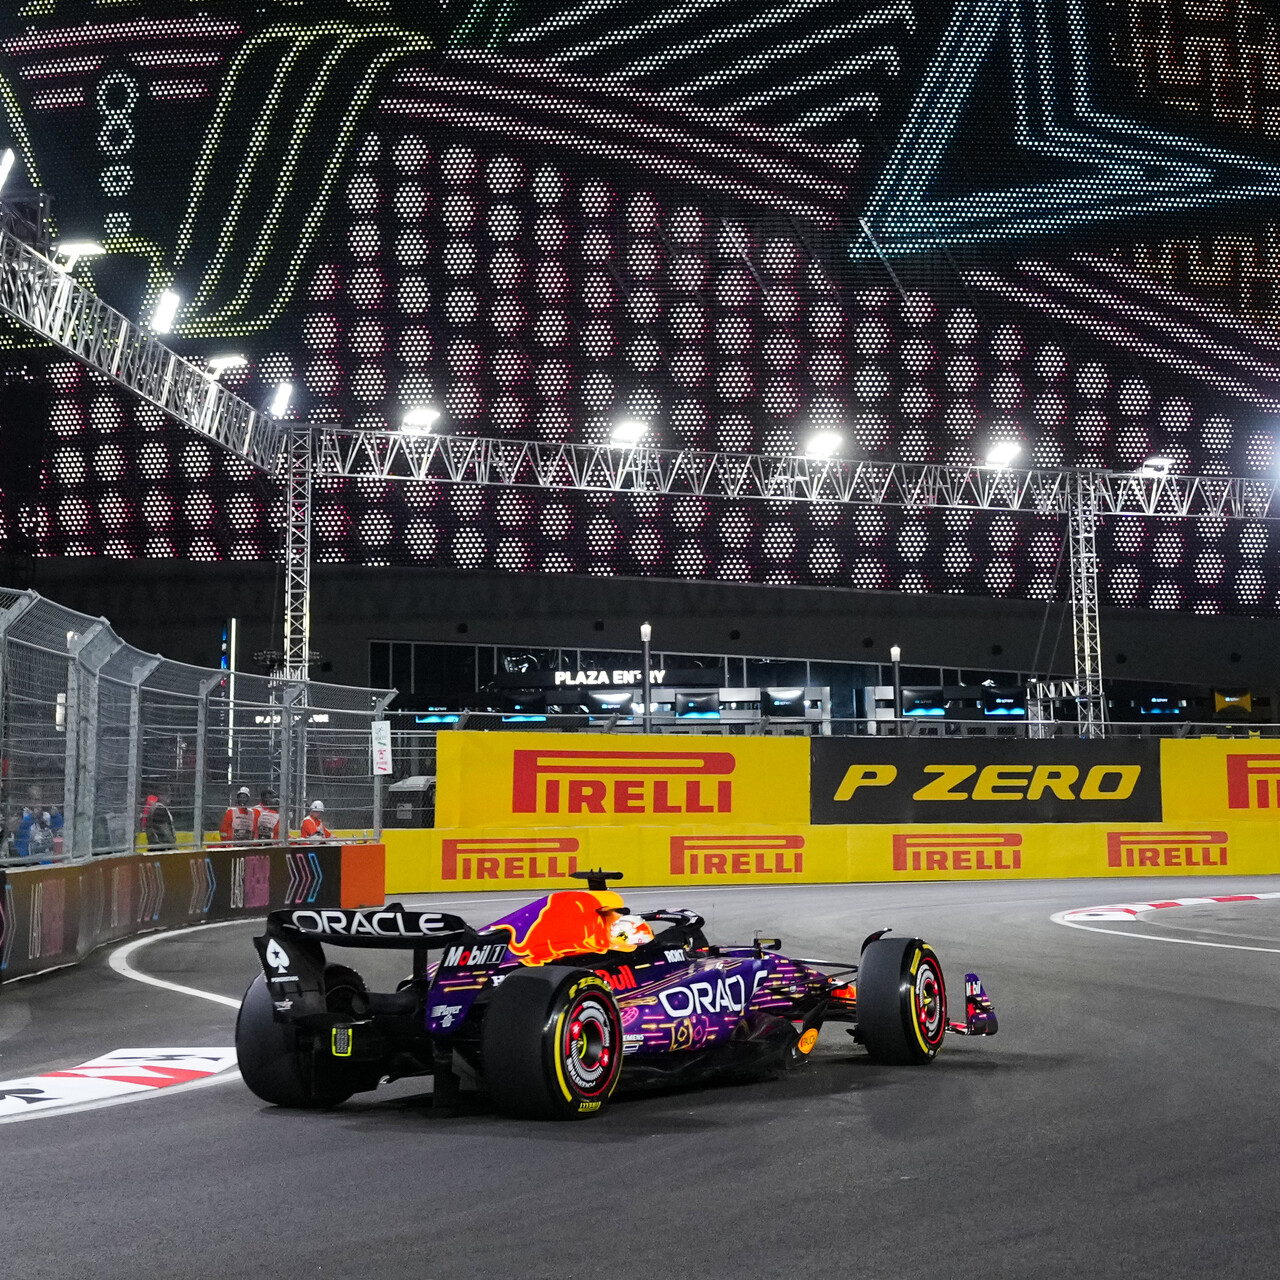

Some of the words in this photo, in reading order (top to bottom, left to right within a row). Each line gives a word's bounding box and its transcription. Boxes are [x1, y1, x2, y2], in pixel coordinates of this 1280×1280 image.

[555, 670, 609, 685] PLAZA
[512, 749, 736, 814] PIRELLI
[833, 764, 896, 801] P
[912, 764, 1141, 801] ZERO
[441, 837, 579, 880] PIRELLI
[670, 835, 805, 876] PIRELLI
[892, 833, 1023, 872] PIRELLI
[1107, 830, 1228, 868] PIRELLI
[291, 910, 445, 936] ORACLE
[444, 945, 491, 967] Mobil
[664, 949, 685, 964] ROKT
